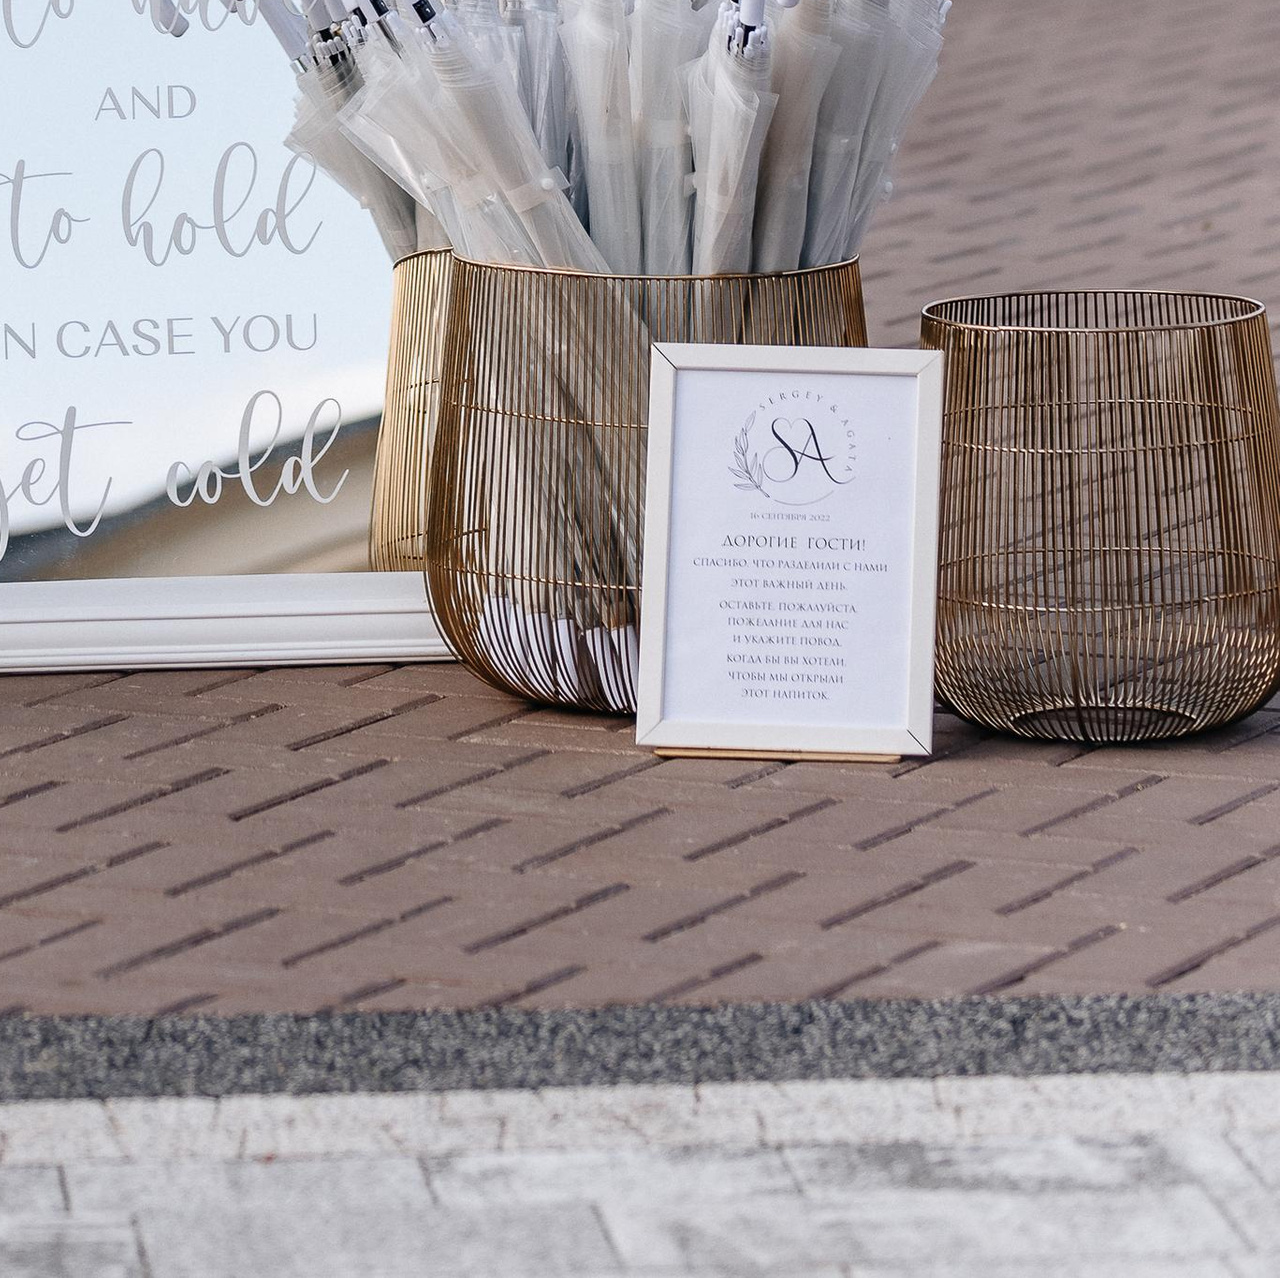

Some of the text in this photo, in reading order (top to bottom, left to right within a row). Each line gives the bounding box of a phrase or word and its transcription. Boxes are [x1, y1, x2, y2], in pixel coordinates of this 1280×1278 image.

[94, 85, 197, 121] AND
[121, 141, 322, 268] hold
[56, 317, 195, 360] CASE
[209, 313, 318, 354] YOU
[165, 389, 351, 508] cold
[721, 534, 867, 552] ДОРОГИЕ ГОСТИ!
